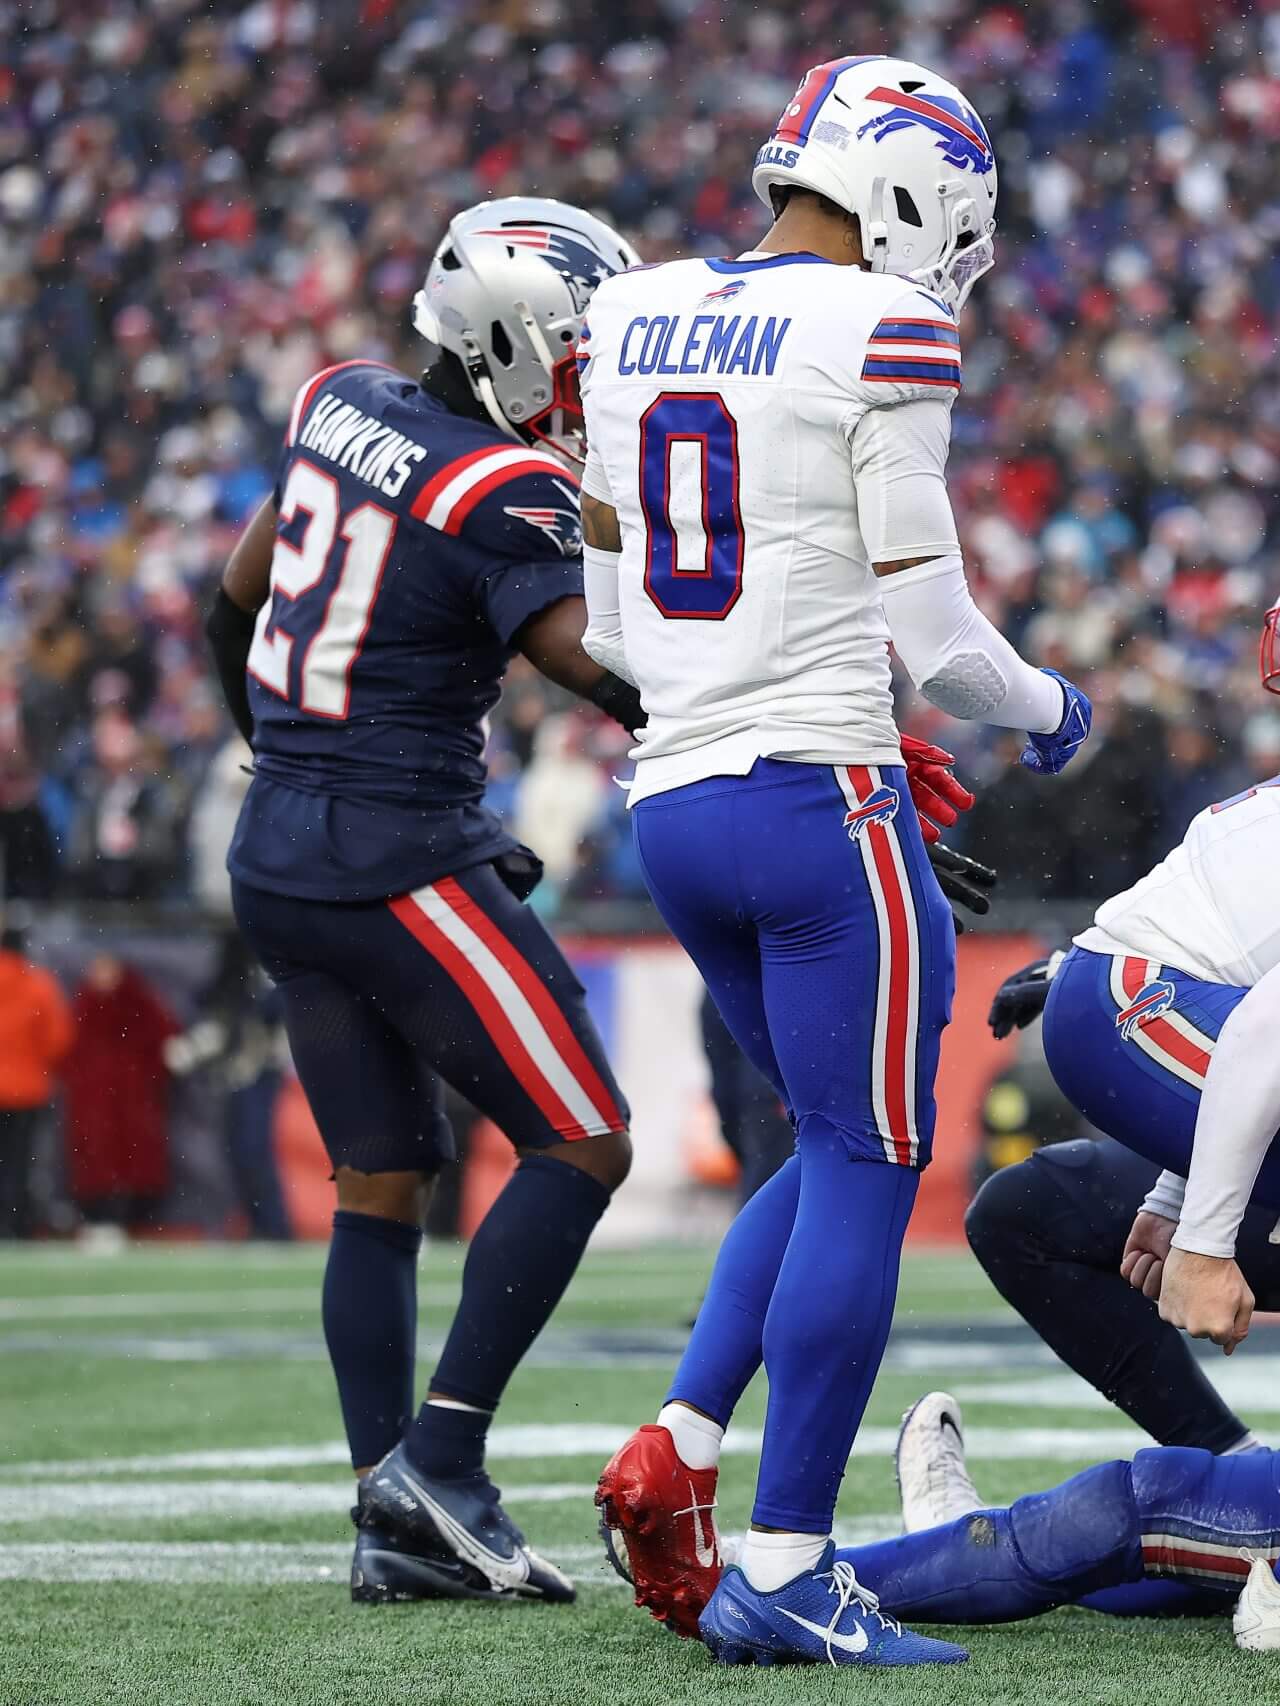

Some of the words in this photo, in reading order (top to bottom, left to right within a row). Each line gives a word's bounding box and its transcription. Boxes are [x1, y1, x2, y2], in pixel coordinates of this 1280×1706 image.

[618, 315, 792, 376] COLEMAN
[300, 392, 427, 498] HAWKINS
[639, 391, 745, 621] 0
[246, 457, 398, 720] 21
